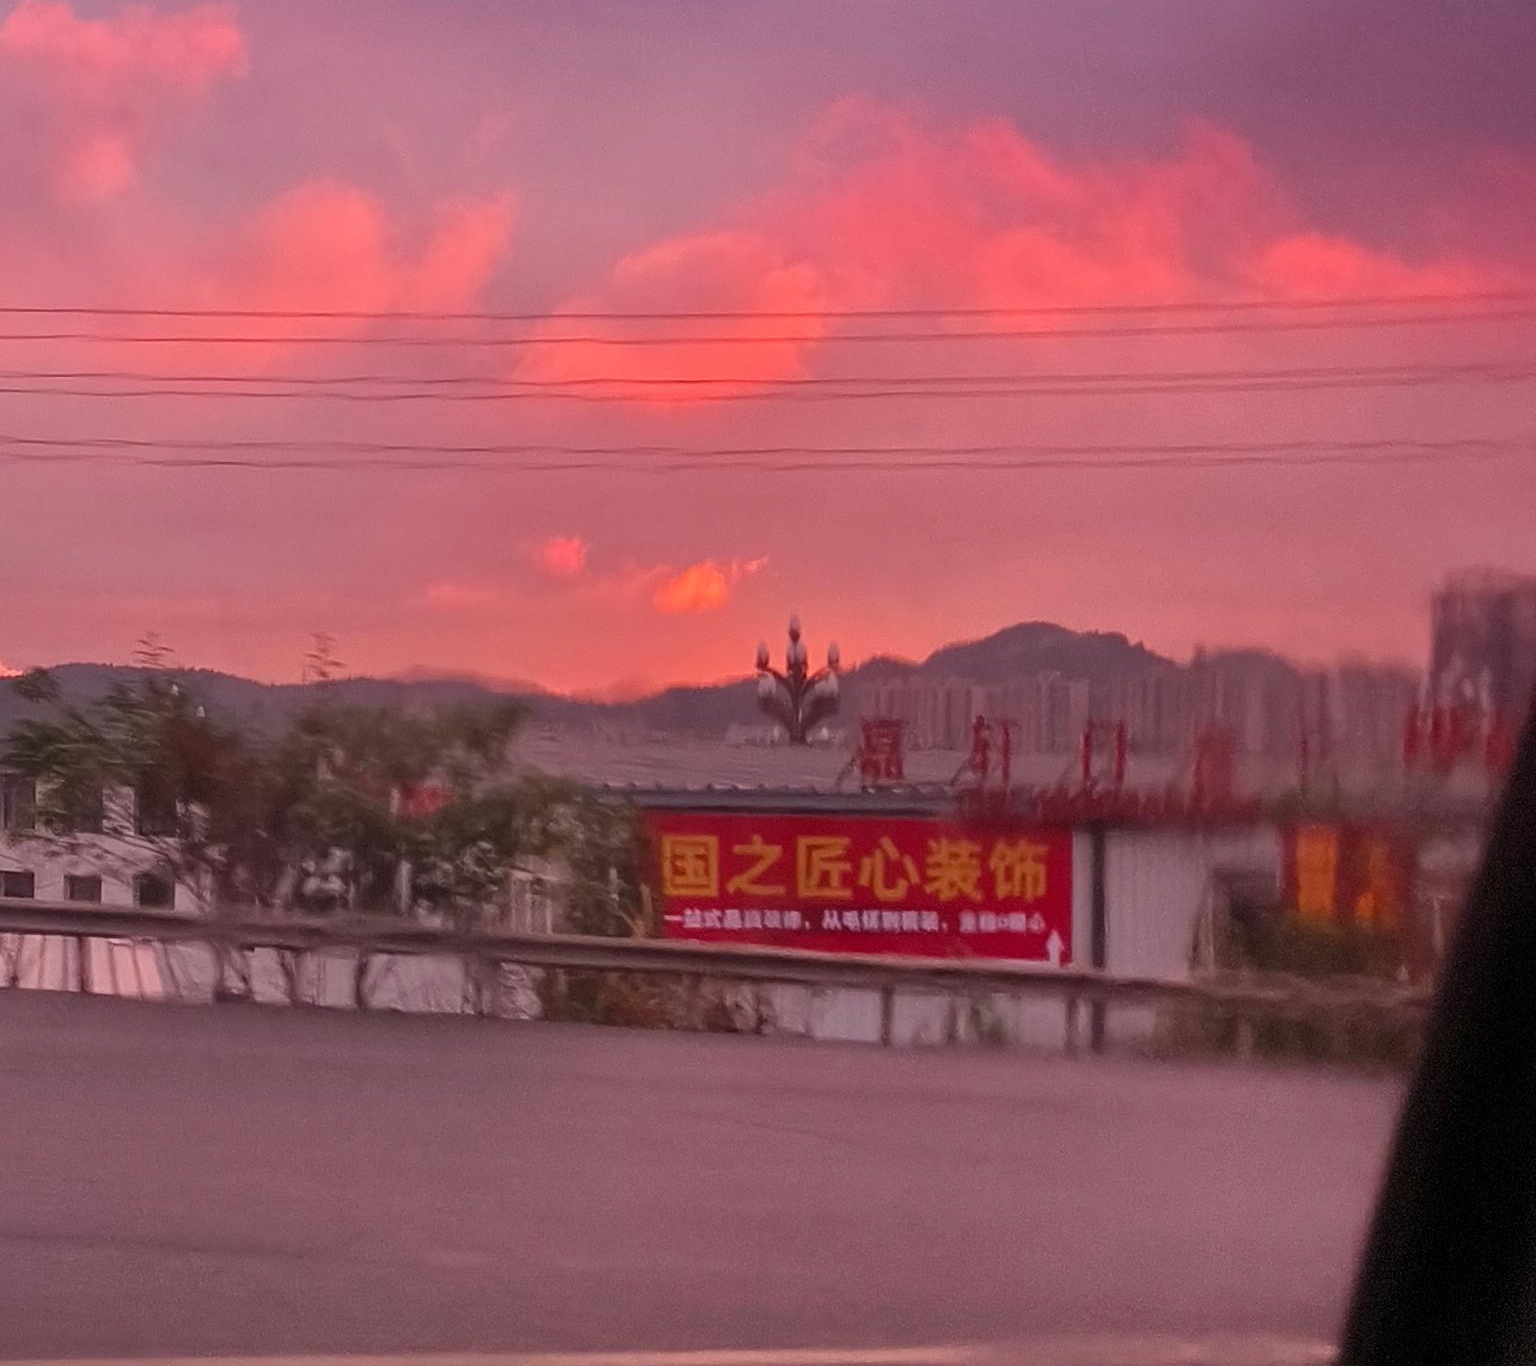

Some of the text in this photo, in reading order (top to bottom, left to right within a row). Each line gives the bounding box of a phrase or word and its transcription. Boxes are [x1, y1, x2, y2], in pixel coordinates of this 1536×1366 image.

[661, 834, 1049, 902] 国之匠心装饰
